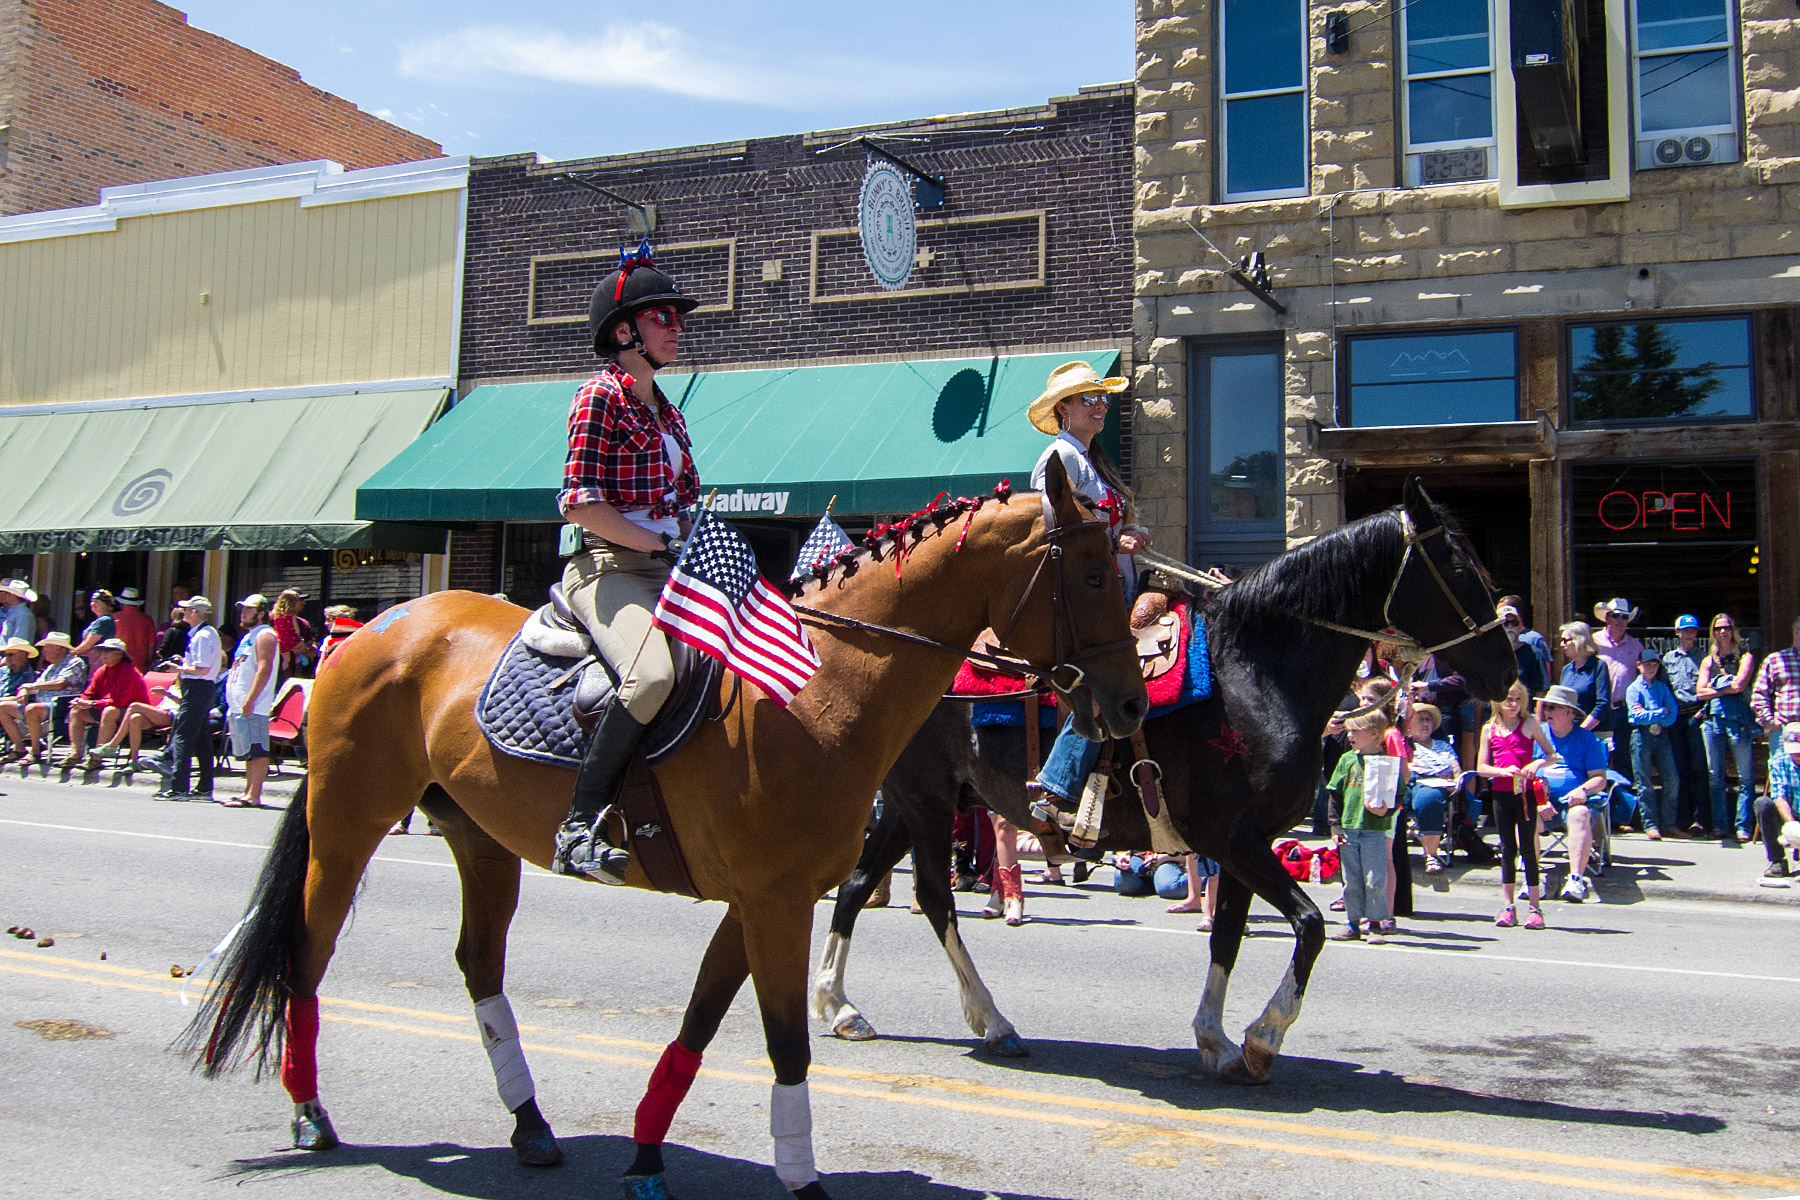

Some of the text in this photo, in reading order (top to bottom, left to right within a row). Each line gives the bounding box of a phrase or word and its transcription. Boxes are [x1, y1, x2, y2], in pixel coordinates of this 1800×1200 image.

[867, 179, 910, 231] BUNNY'S BRUSH
[690, 489, 790, 515] roadway
[1599, 490, 1731, 530] OPEN
[12, 526, 206, 549] MYSTIC MOUNTAIN
